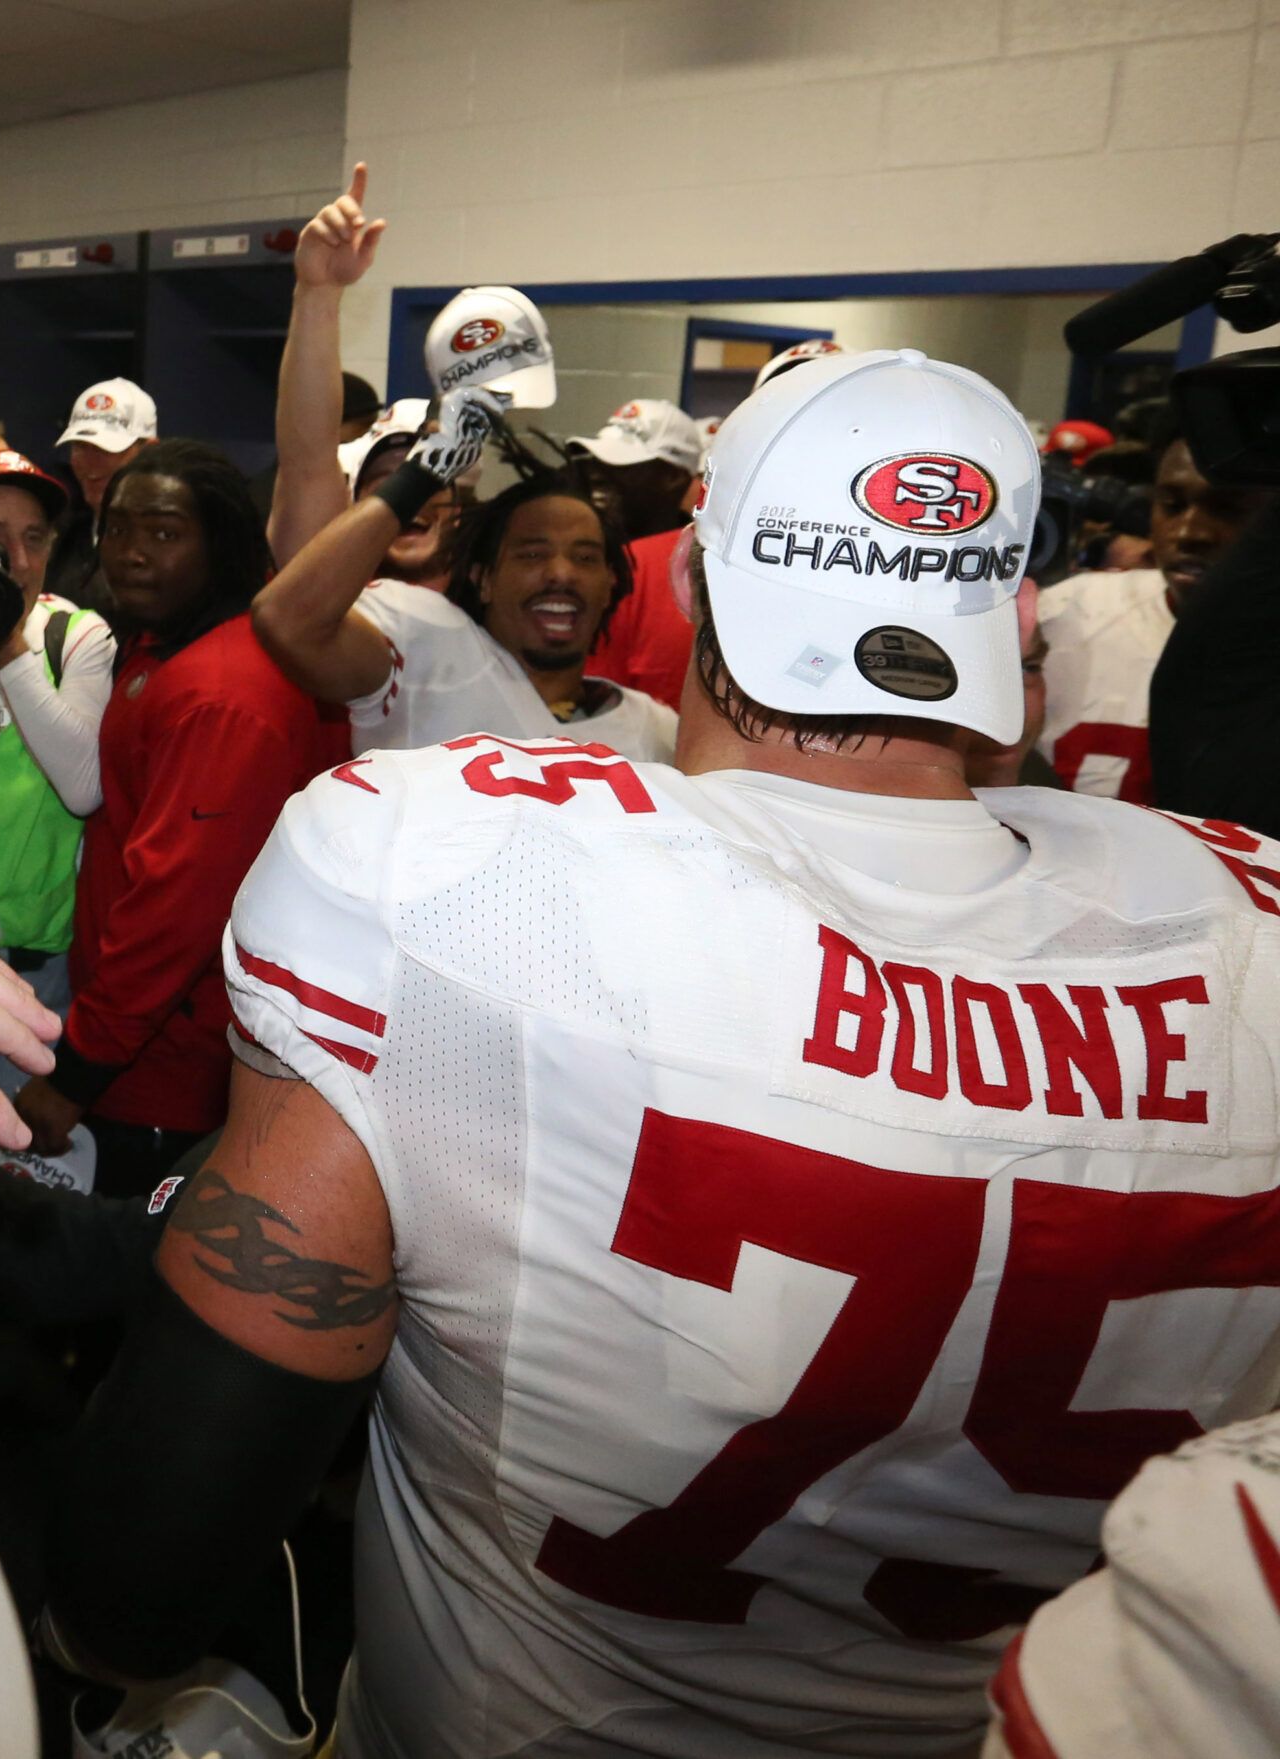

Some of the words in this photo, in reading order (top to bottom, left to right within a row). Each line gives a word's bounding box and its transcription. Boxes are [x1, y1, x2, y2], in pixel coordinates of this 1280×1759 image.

[441, 337, 538, 392] CHAMPIONS
[758, 505, 797, 518] 2012
[894, 461, 979, 528] SF
[756, 517, 871, 538] CONFERENCE
[752, 530, 1025, 582] CHAMPIONS
[803, 923, 1209, 1124] BOONE
[534, 1107, 1280, 1641] 75
